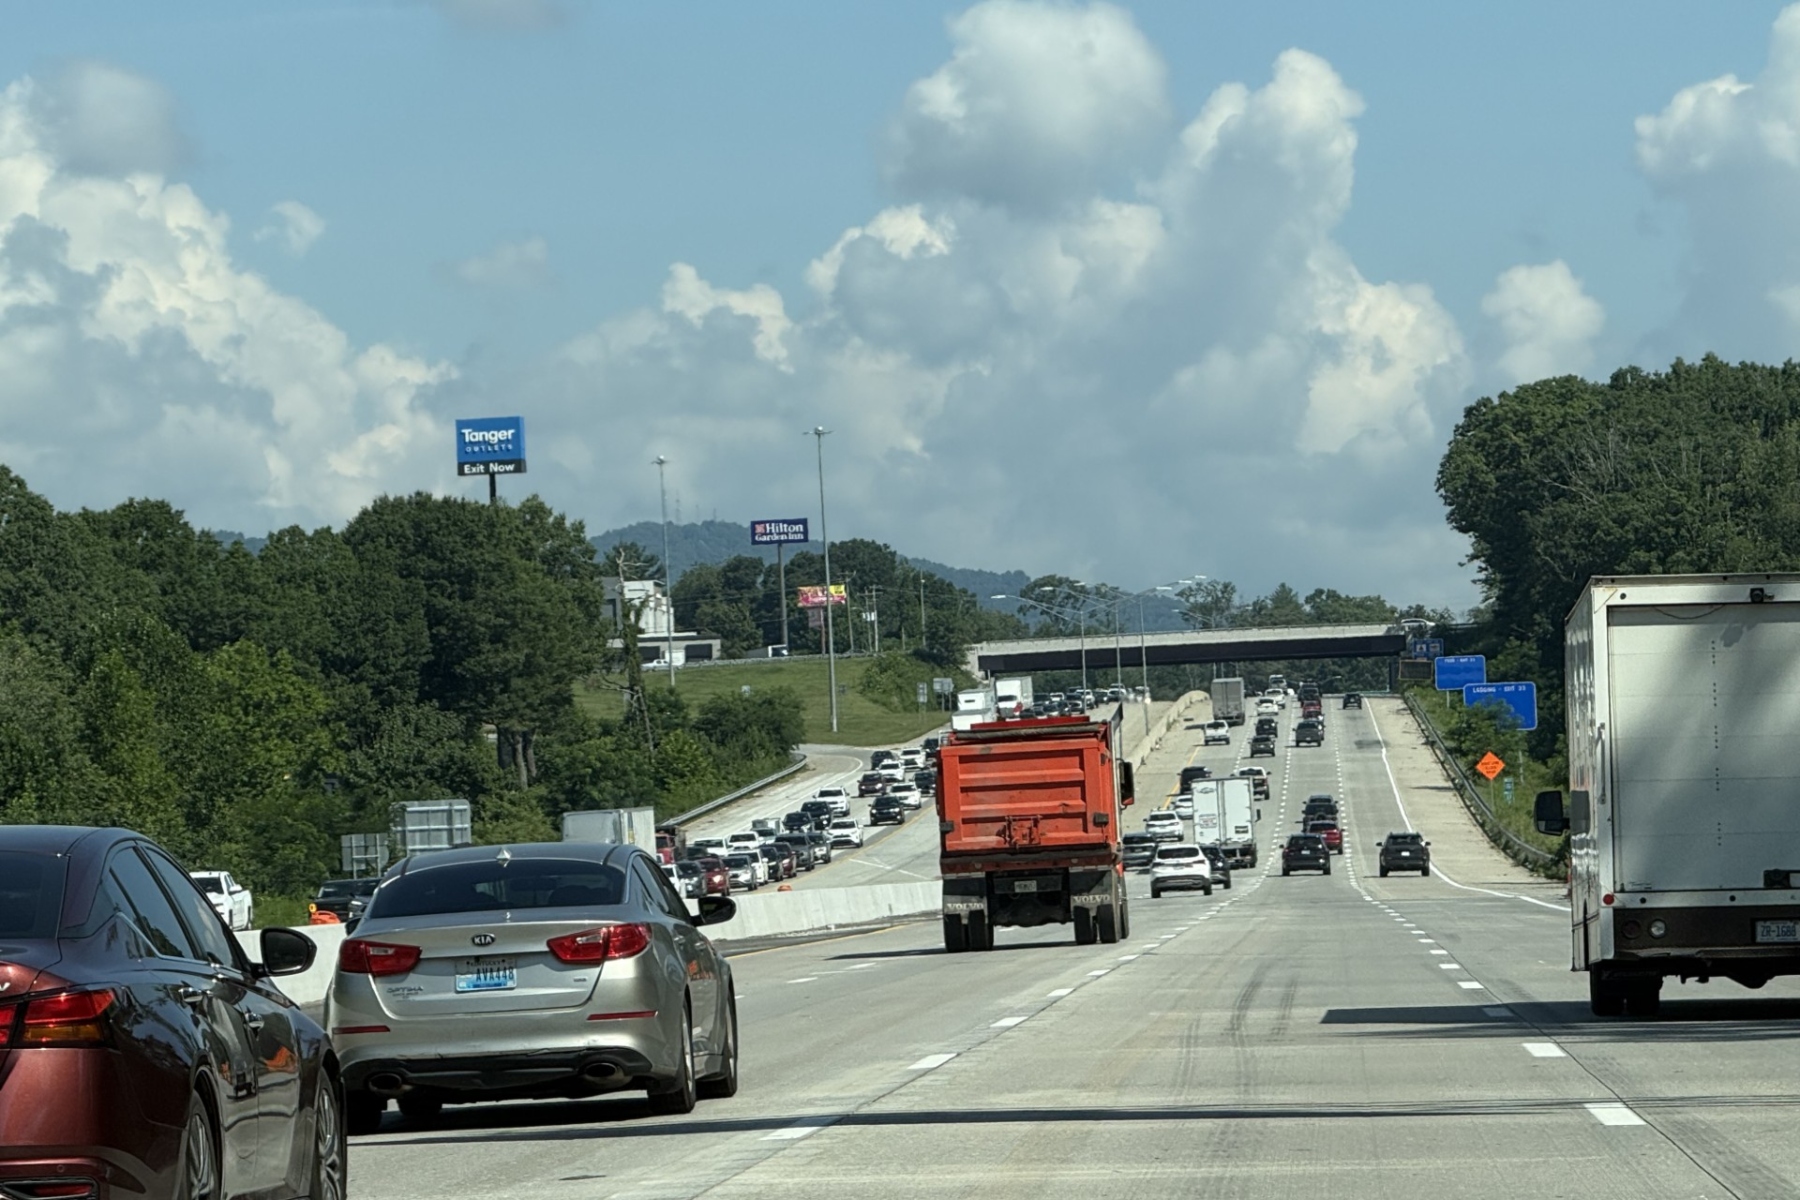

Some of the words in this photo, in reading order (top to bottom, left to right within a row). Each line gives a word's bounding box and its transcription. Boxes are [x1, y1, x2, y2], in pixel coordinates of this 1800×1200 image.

[461, 428, 516, 444] Tanger
[465, 444, 513, 453] OUTLETS
[464, 463, 485, 474] Exit
[489, 462, 515, 473] Now
[766, 523, 804, 533] Hilton
[755, 533, 788, 541] Garden
[788, 532, 804, 540] Inn
[1073, 894, 1111, 904] VOLVO
[946, 902, 985, 911] VOLVO
[474, 935, 493, 945] KIA
[476, 966, 514, 982] AVA448
